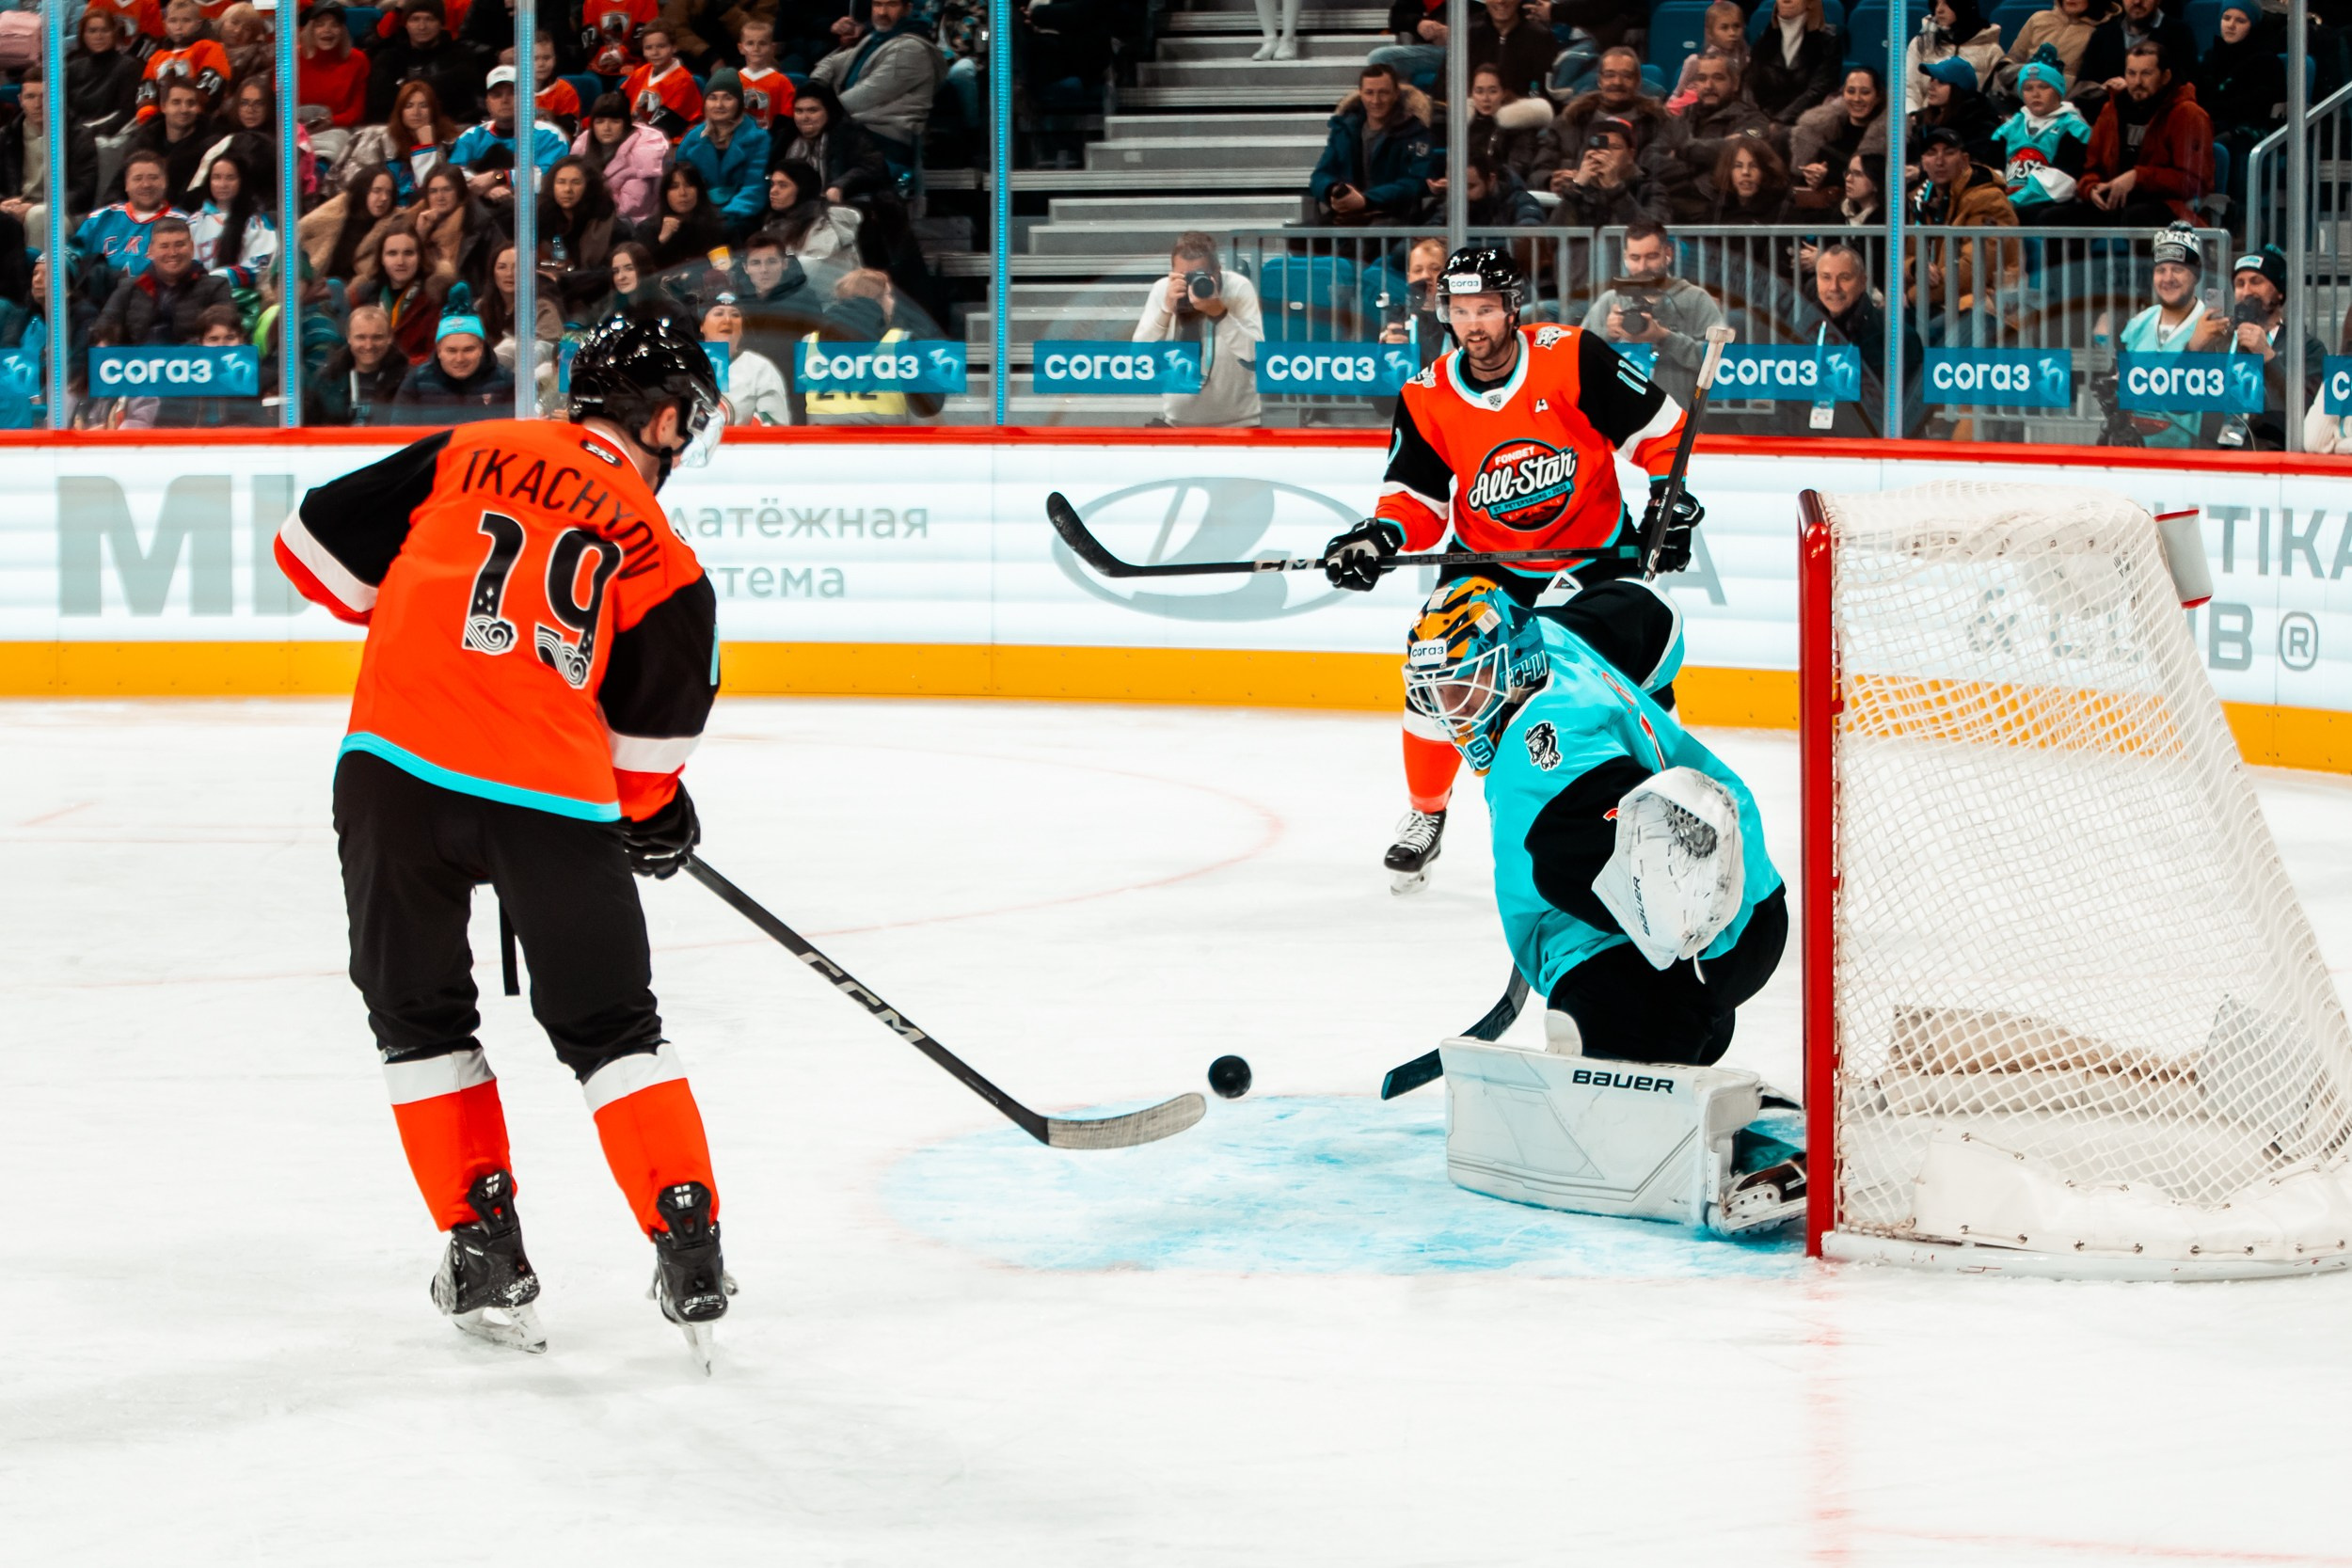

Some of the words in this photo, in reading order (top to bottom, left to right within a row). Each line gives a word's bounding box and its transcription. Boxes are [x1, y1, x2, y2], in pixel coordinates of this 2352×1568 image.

[99, 358, 212, 385] согаз
[804, 355, 919, 381] согаз
[1044, 354, 1155, 381] согаз
[1265, 355, 1375, 382] согаз
[1714, 357, 1819, 387] согаз
[1933, 361, 2030, 391] согаз
[2127, 366, 2225, 397] согаз
[1494, 446, 1535, 467] FONBET
[1469, 451, 1577, 508] All-Star
[462, 449, 660, 581] TKACHYOV
[1504, 492, 1548, 510] PETERSBURG
[669, 498, 929, 539] латёжная
[1409, 553, 1491, 564] RIBCOR
[705, 566, 845, 599] тема
[462, 510, 624, 689] 19
[1411, 646, 1444, 657] согаз
[799, 951, 927, 1044] CCM
